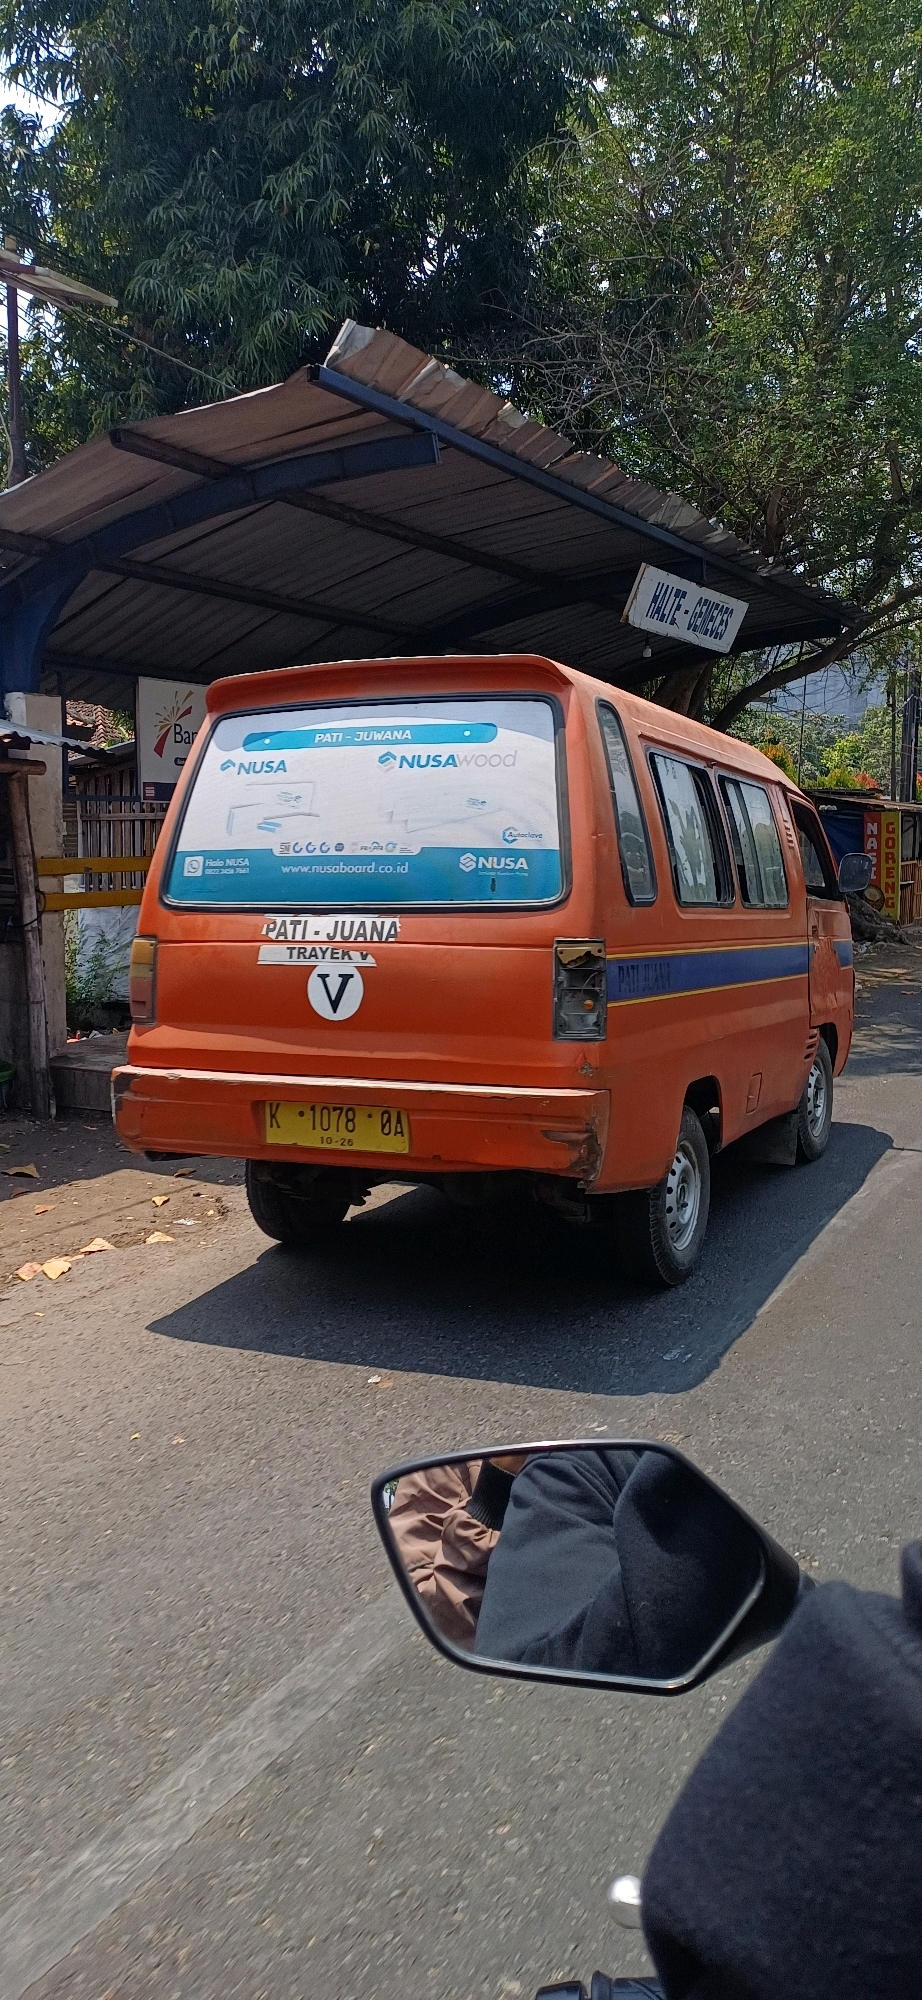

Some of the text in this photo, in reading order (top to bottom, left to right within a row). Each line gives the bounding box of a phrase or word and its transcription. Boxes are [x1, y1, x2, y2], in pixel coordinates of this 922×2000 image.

[645, 581, 688, 626] HALTE
[314, 732, 343, 744] PATI
[353, 729, 412, 741] JUWANA
[237, 759, 287, 775] NUSA
[225, 857, 250, 867] NUSA
[281, 861, 409, 874] www.nusaboard.co.id
[477, 856, 529, 870] NUSA
[884, 821, 896, 909] GORENG
[265, 919, 309, 940] PATI
[326, 920, 398, 942] JUANA
[286, 946, 353, 961] TRAYEK
[316, 973, 355, 1014] V
[269, 1102, 281, 1129] K
[309, 1104, 357, 1134] 1078
